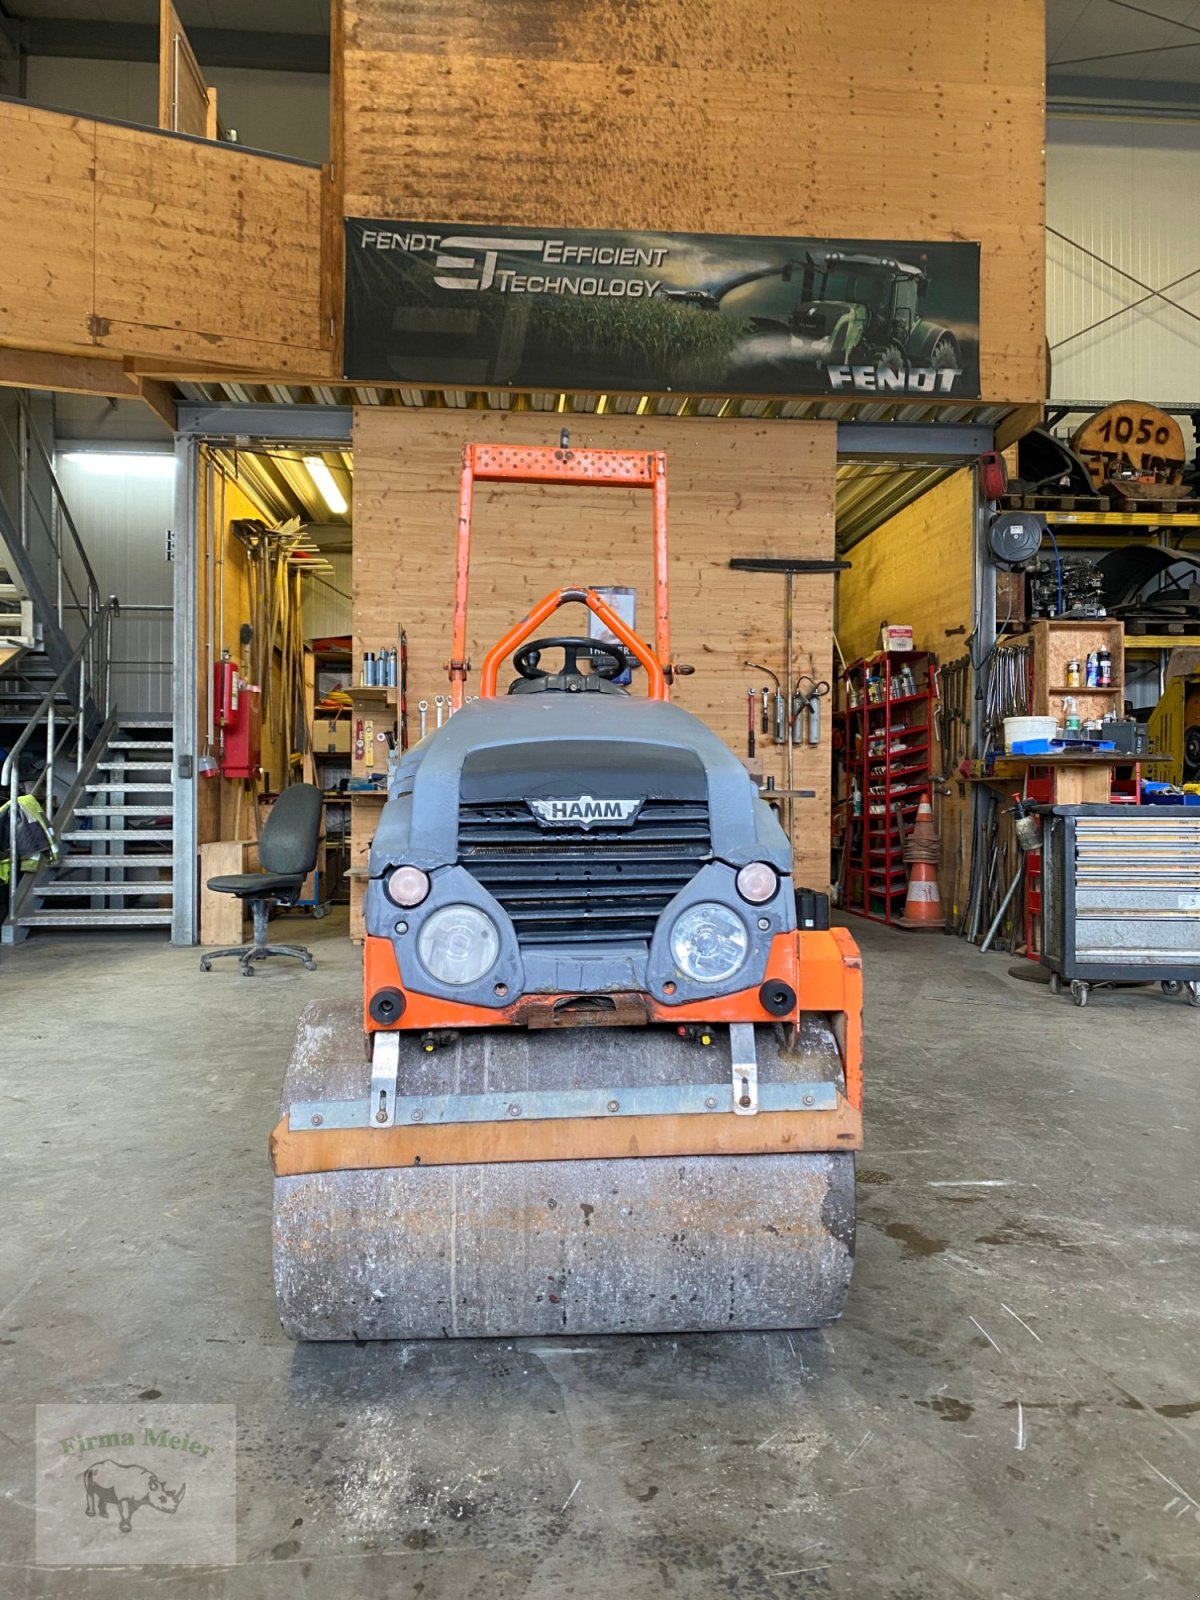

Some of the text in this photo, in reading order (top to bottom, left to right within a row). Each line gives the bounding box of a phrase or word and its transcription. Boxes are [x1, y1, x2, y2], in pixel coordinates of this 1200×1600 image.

[361, 230, 442, 252] FENDT
[543, 240, 668, 267] EFFICIENT
[496, 269, 661, 297] TECHNOLOGY
[827, 365, 963, 392] FENDT
[1099, 416, 1169, 444] 1050
[552, 802, 622, 818] HAMM
